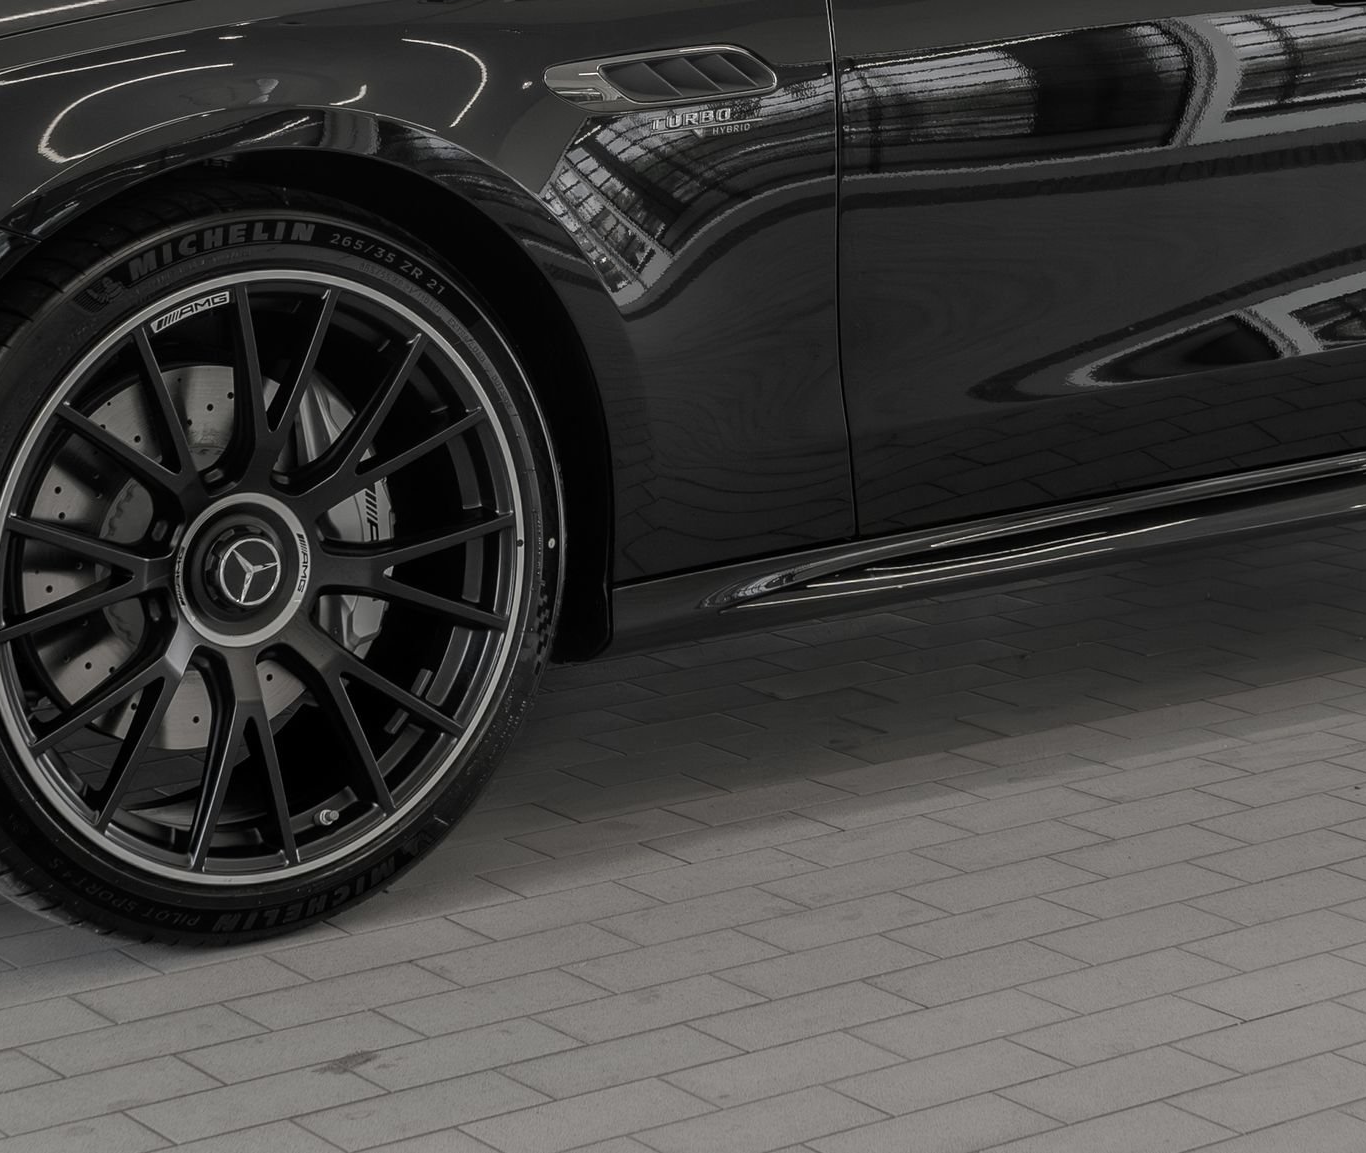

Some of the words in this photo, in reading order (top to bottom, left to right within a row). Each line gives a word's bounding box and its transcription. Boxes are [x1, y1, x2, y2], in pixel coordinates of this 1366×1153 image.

[650, 107, 732, 131] TURBO
[712, 123, 751, 135] HYBRID
[127, 221, 316, 282] MICHELIN
[328, 232, 397, 265] 265/35
[398, 257, 425, 281] ZR
[425, 277, 447, 296] 21
[178, 292, 227, 319] AMG
[298, 551, 310, 593] AMG
[212, 855, 396, 933] MICHELIN
